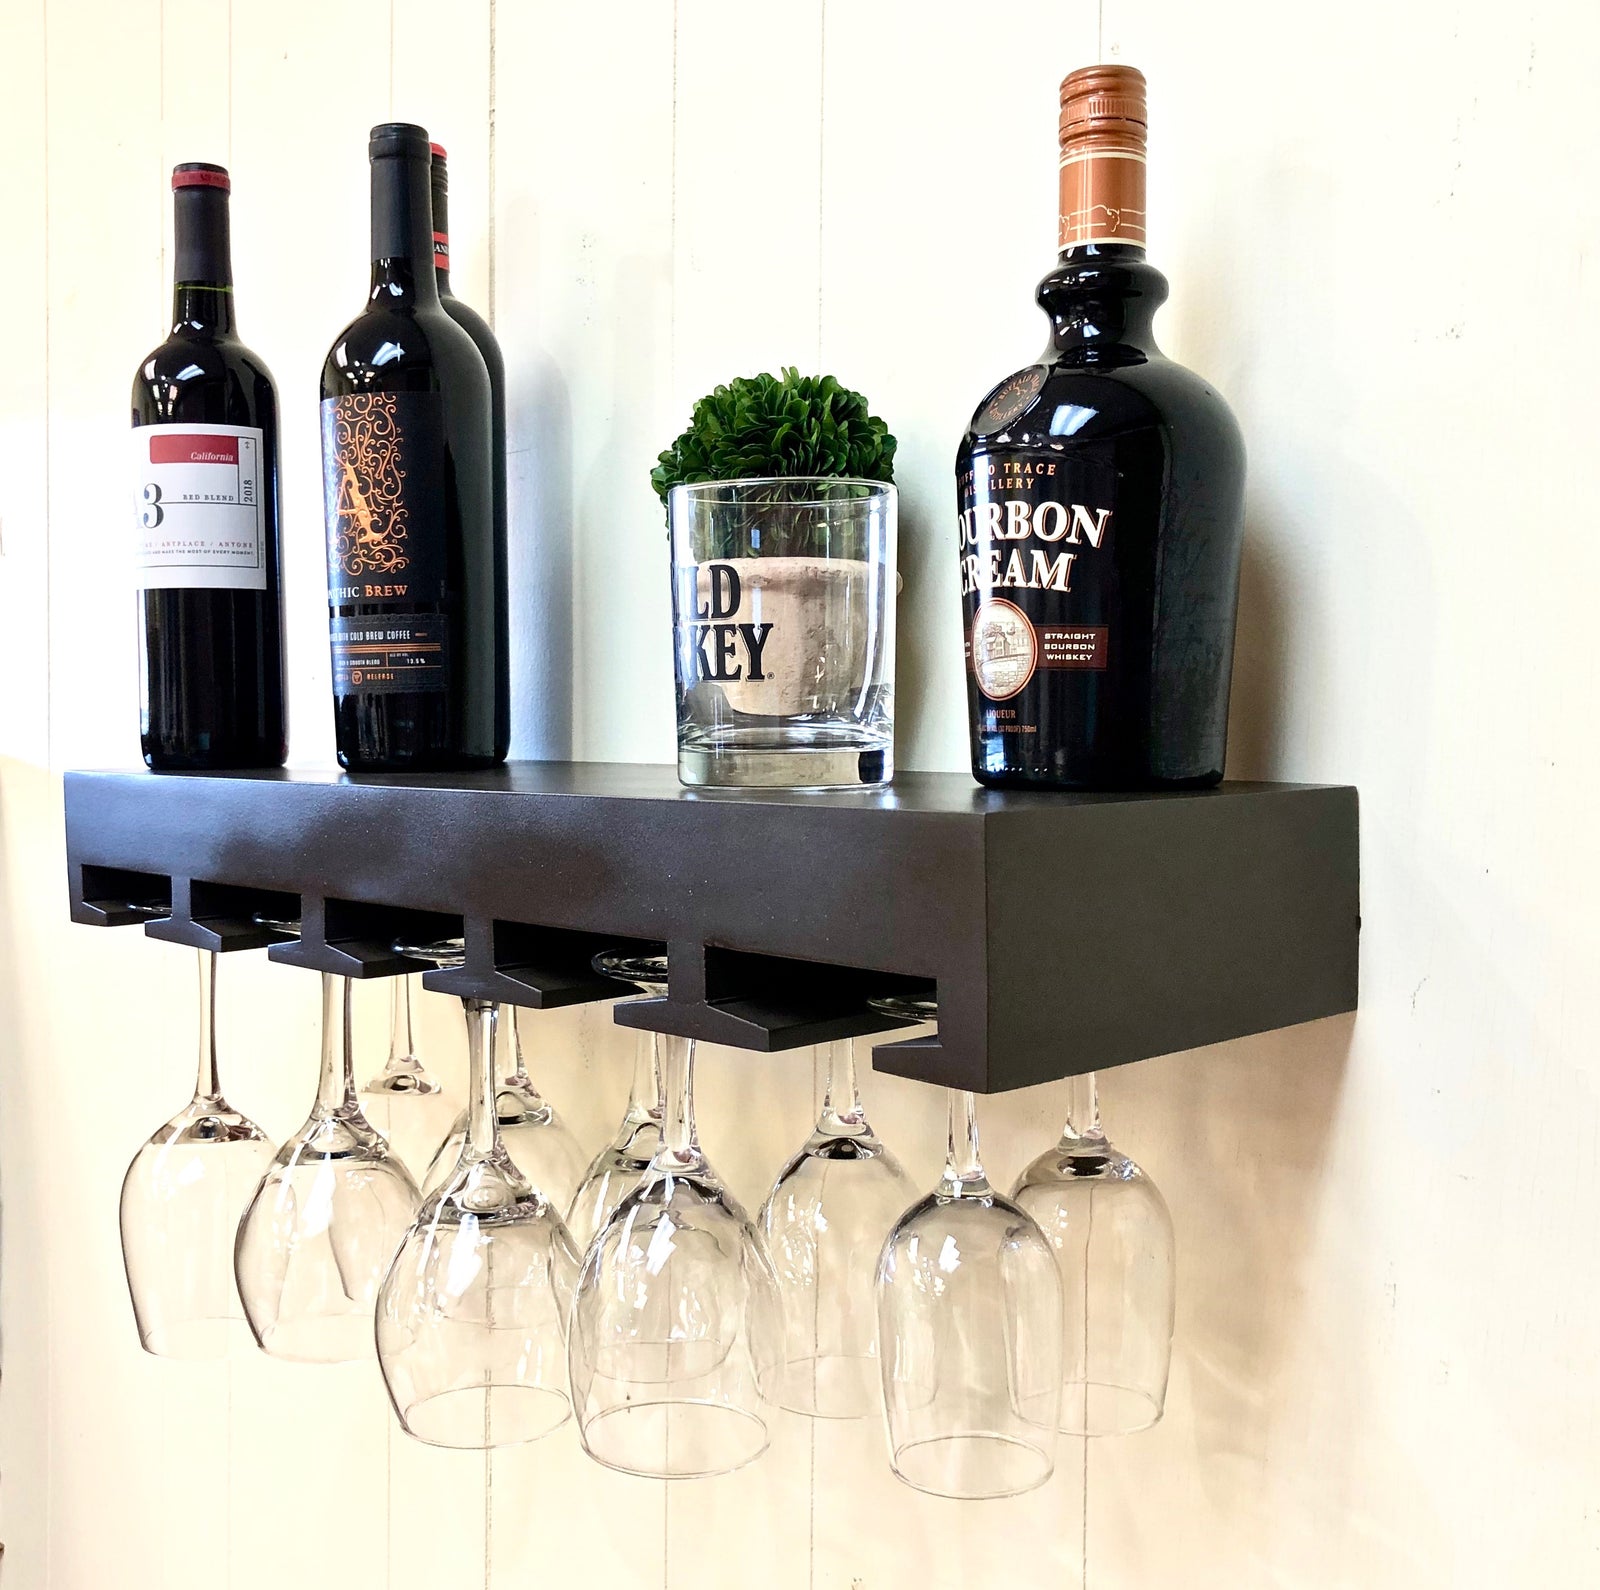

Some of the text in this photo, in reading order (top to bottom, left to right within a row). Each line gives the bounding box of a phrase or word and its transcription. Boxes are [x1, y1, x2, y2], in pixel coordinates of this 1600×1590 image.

[190, 452, 234, 462] California
[1003, 462, 1057, 476] TRACE
[243, 479, 254, 503] 2018
[204, 494, 234, 502] BLEND
[960, 547, 1077, 597] CREAM
[364, 584, 408, 597] BREW
[350, 631, 364, 641] COLD
[365, 630, 384, 641] BREW
[386, 629, 411, 640] COFFEE
[1044, 643, 1096, 651] BOURBON
[1046, 653, 1093, 661] WHISKEY
[986, 709, 1016, 719] LIQUEUR
